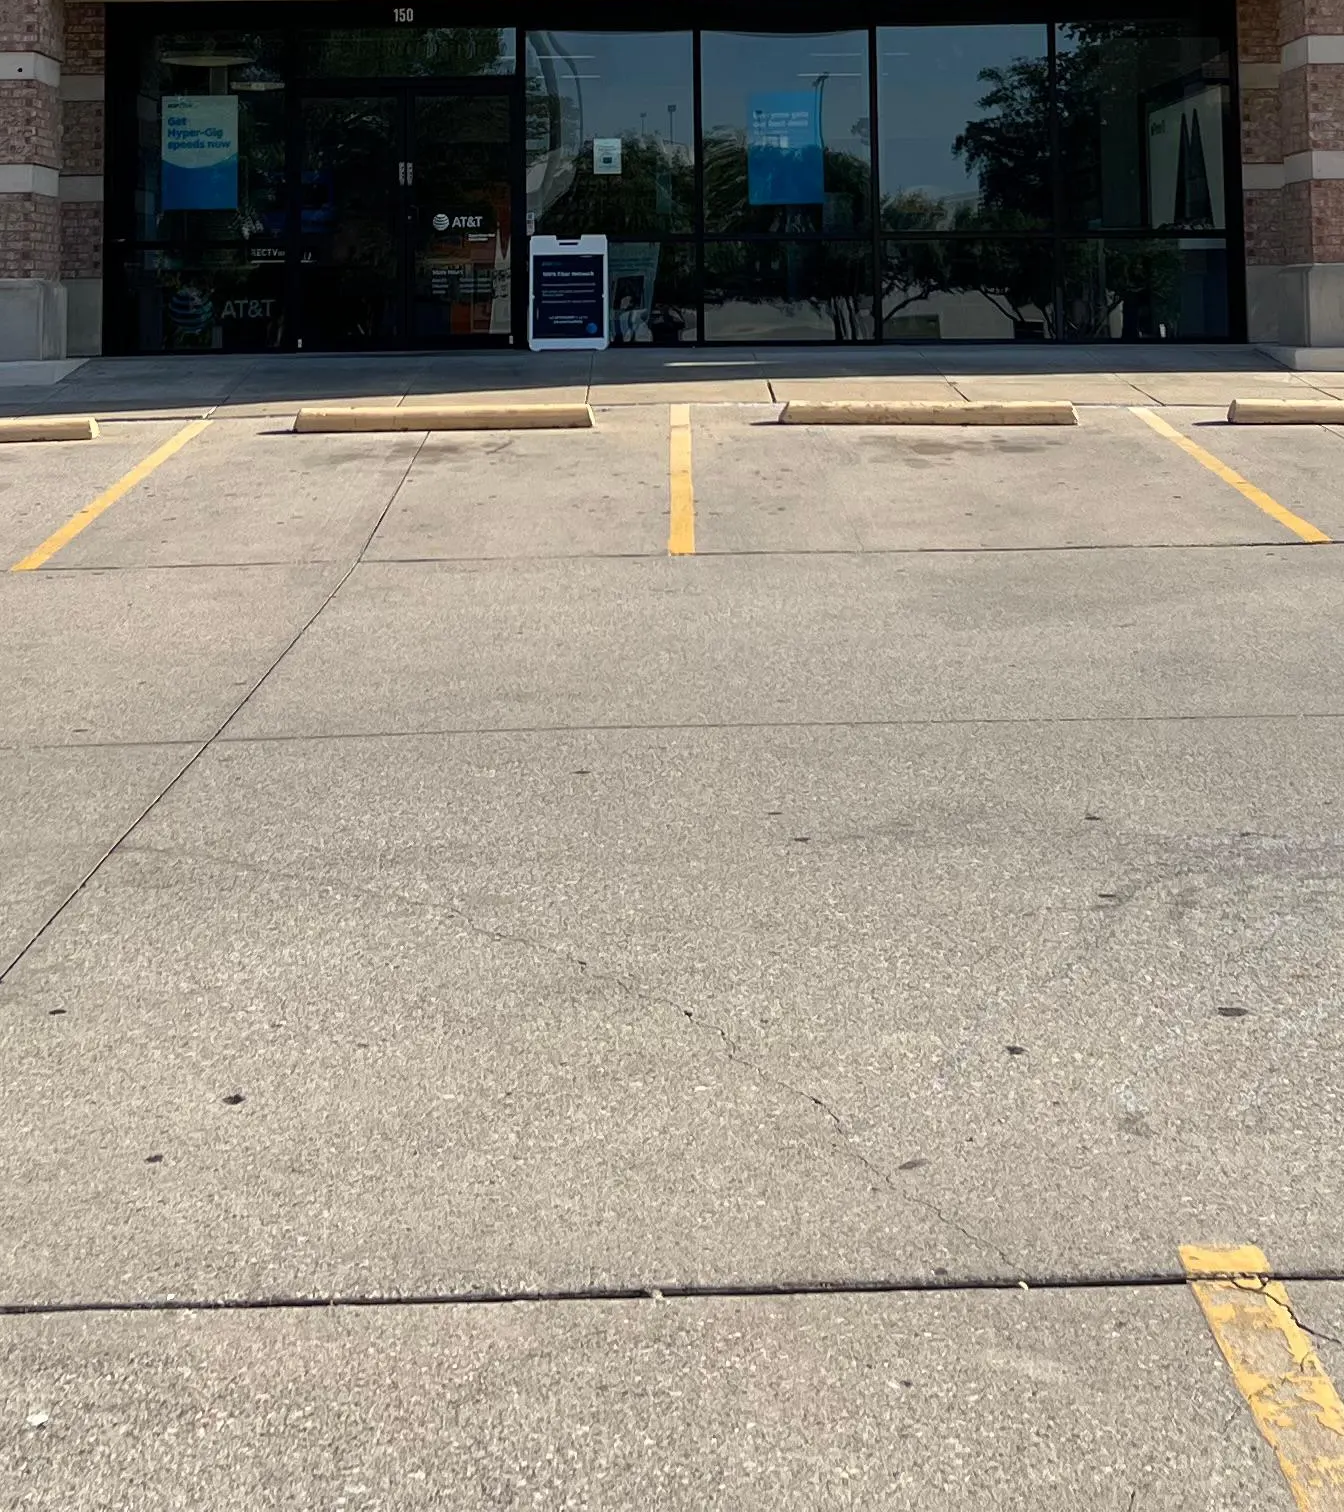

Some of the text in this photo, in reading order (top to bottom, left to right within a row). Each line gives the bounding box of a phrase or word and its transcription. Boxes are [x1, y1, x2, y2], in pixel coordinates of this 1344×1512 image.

[393, 7, 414, 23] 150
[167, 116, 187, 126] Get
[167, 127, 224, 140] Hyper-Gig
[167, 139, 231, 150] speeds now
[452, 215, 484, 228] AT&T
[220, 299, 277, 319] AT&T
